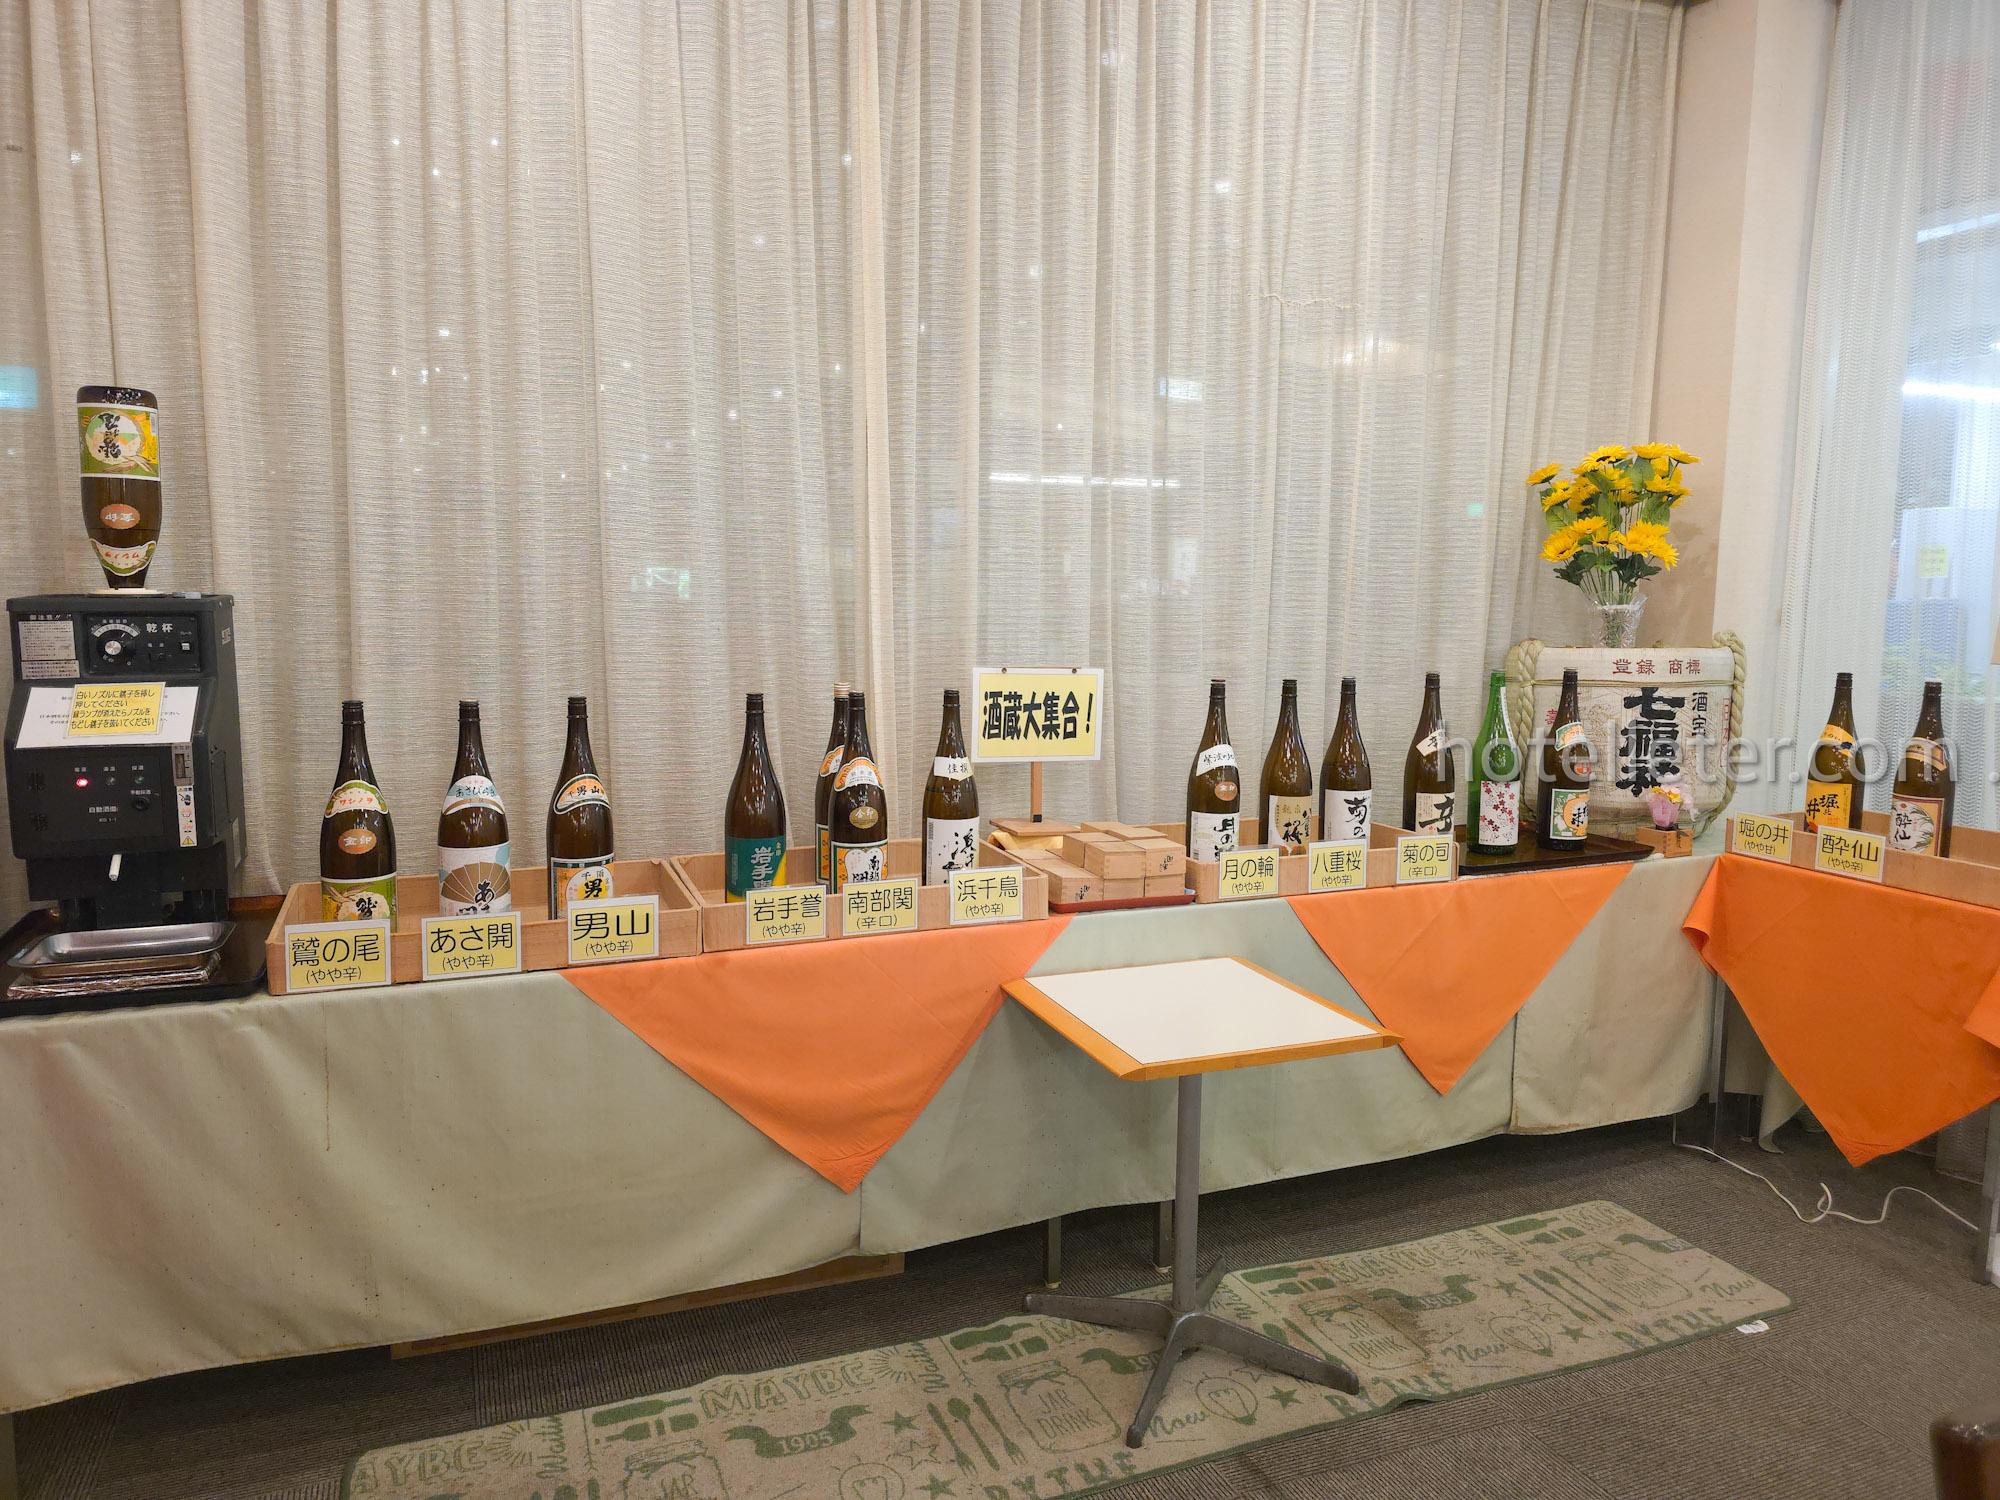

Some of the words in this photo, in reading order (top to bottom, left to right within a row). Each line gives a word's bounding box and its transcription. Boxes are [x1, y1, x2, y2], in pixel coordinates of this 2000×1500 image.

[75, 699, 129, 709] 押してください
[1343, 796, 1368, 839] 菊の
[1739, 819, 1790, 846] 堀の井
[1313, 850, 1362, 874] 八重桜
[1403, 842, 1450, 864] 菊の司
[1821, 833, 1879, 862] 酔仙
[1222, 856, 1275, 882] 月の輪
[848, 886, 913, 915] 南部関
[957, 876, 1019, 902] 浜千鳥
[752, 893, 823, 922] 岩手誉
[430, 922, 513, 954] あさ開
[573, 909, 650, 941] 男山
[291, 934, 380, 967] 鷲の尾
[699, 1360, 875, 1420] MAYBE
[1038, 1387, 1077, 1416] JAR
[1036, 1406, 1103, 1440] DRINK
[779, 1429, 835, 1455] 1905
